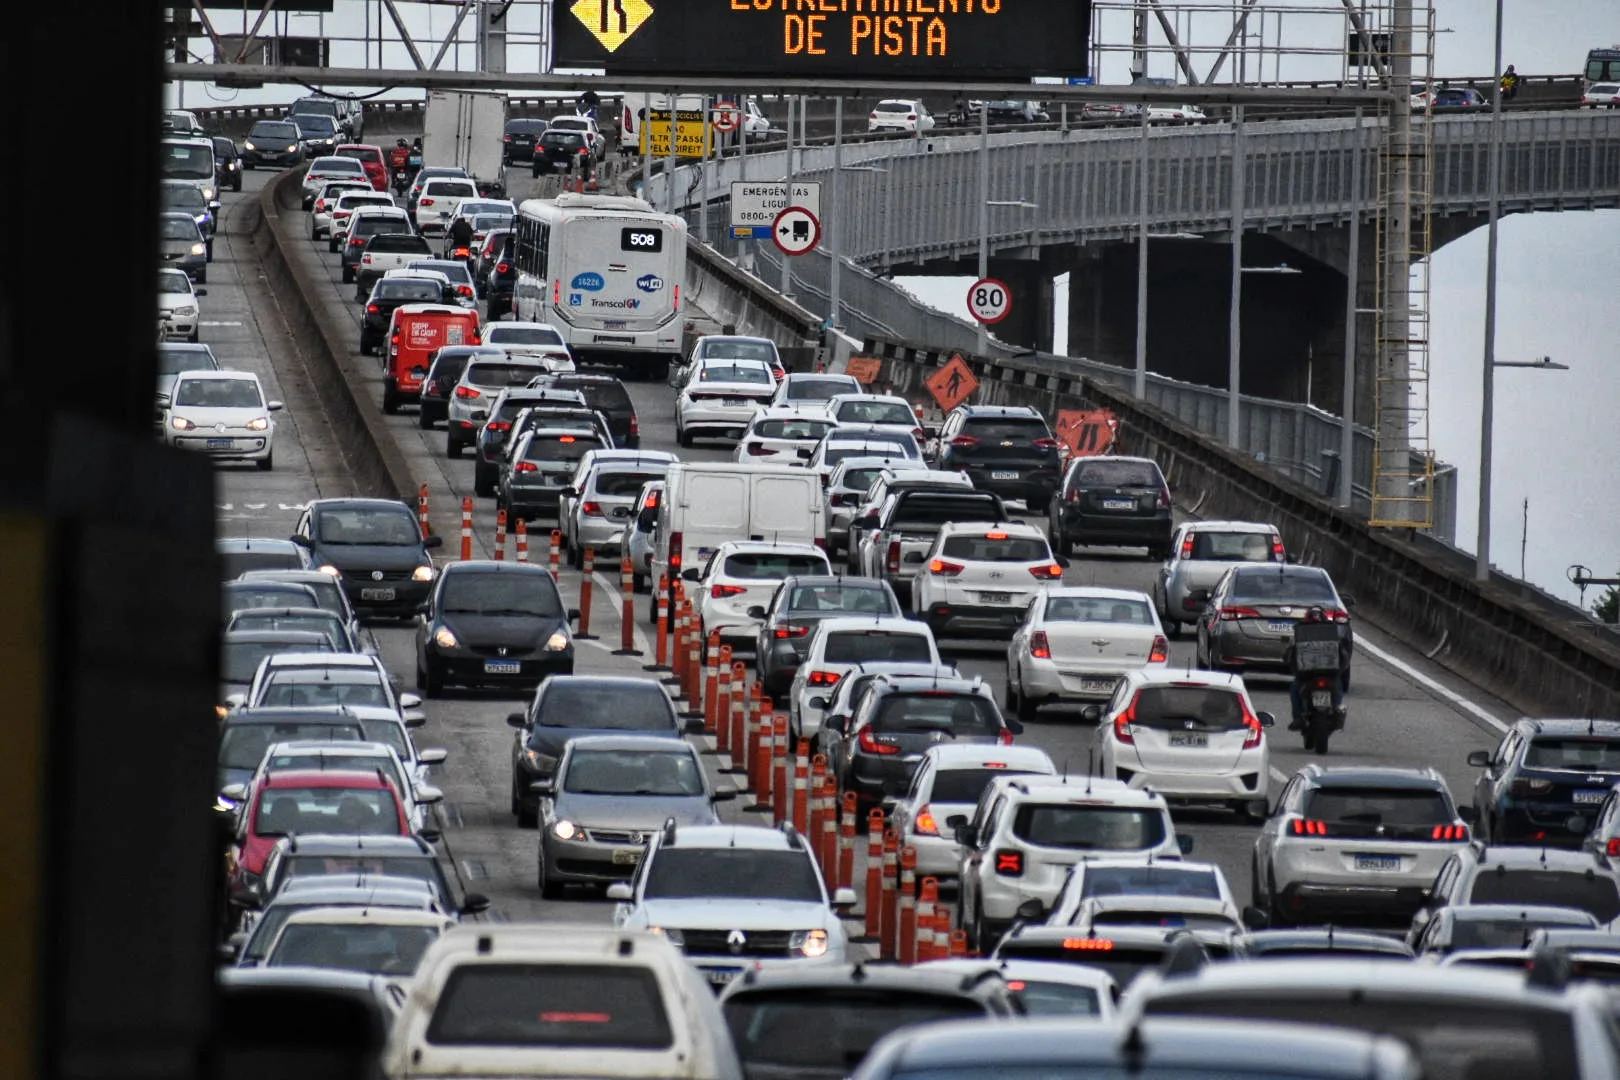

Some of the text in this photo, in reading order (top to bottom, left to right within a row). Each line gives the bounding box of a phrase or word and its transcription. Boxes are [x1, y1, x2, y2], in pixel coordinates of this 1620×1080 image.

[785, 14, 946, 56] DE PISTA
[743, 187, 809, 197] EMERGÊNIAS
[630, 233, 655, 246] 508
[975, 288, 1003, 307] 80
